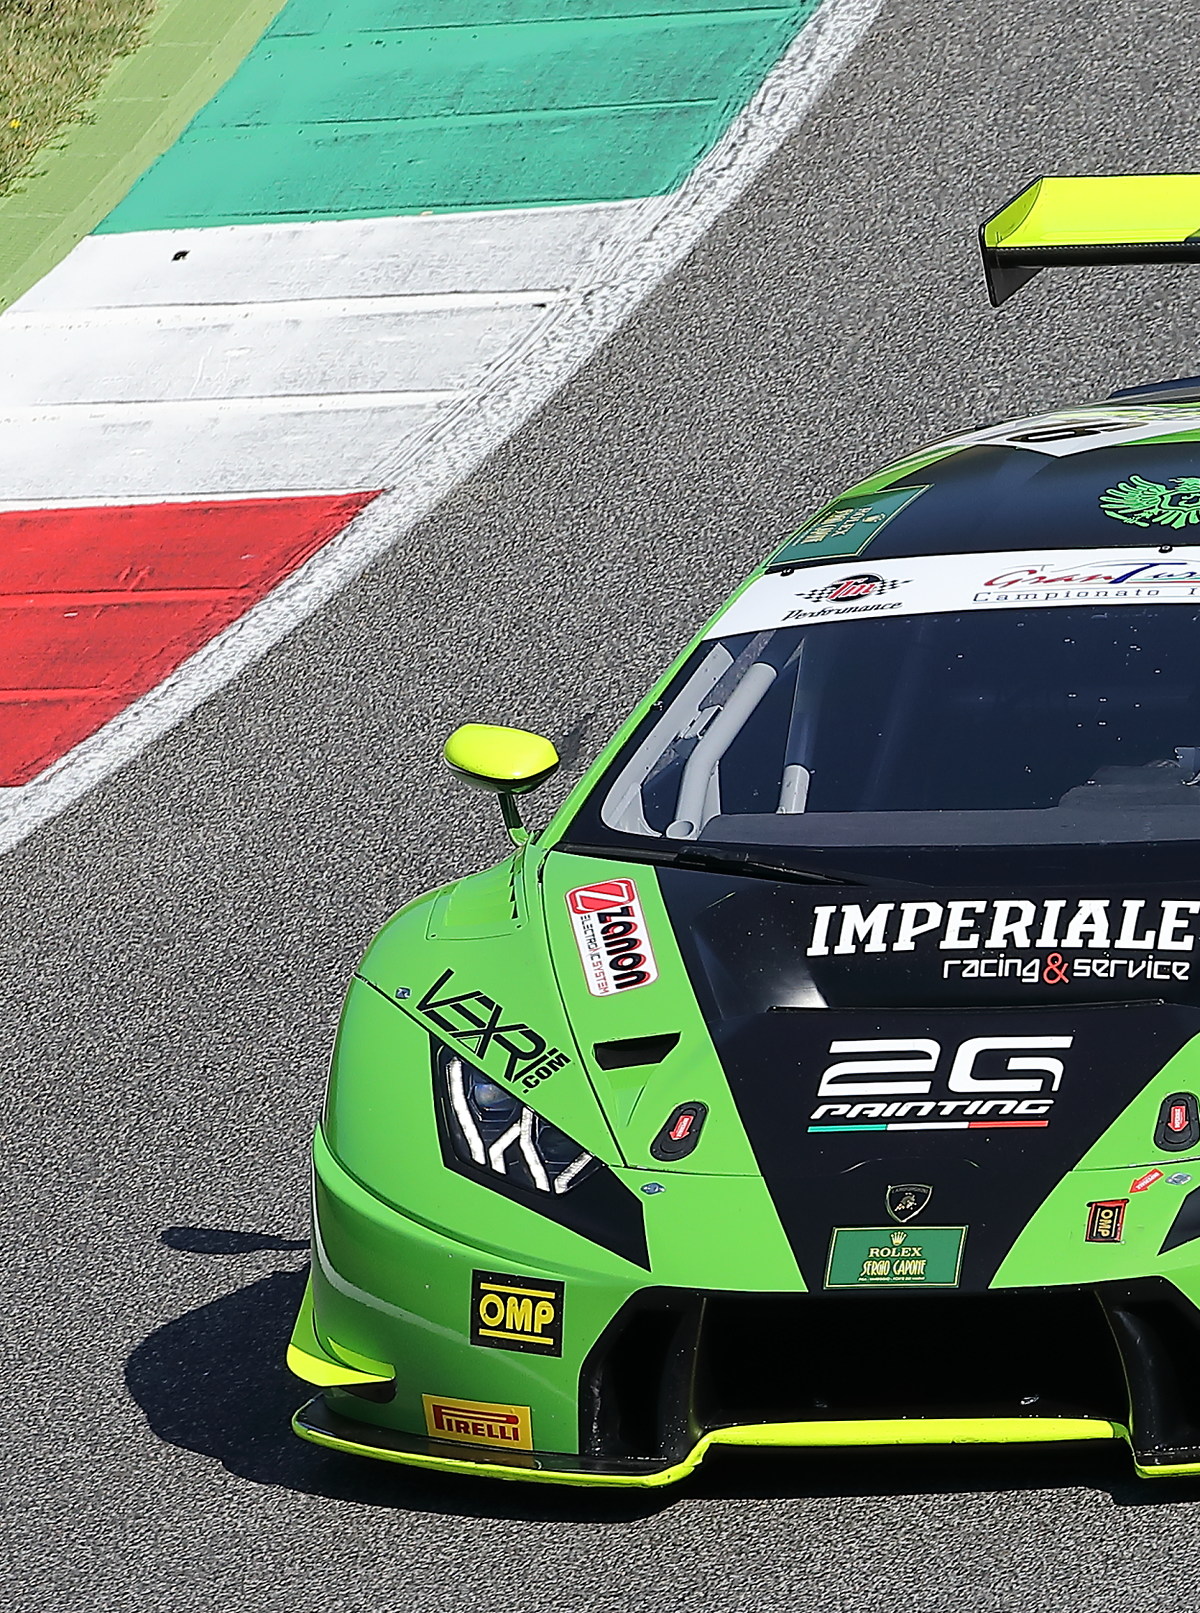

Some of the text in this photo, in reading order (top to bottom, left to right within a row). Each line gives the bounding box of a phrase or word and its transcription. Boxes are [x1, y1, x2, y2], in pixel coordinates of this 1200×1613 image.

[973, 587, 1160, 602] Campionato
[781, 601, 903, 621] Performance
[806, 899, 1200, 957] IMPERIALE
[597, 905, 651, 989] zanon
[592, 961, 609, 994] SYSTEM
[817, 1036, 1074, 1097] 2G
[810, 1099, 1055, 1120] PAINTING
[1098, 1209, 1114, 1237] OMP
[868, 1247, 923, 1257] ROLEX
[860, 1259, 927, 1277] SERGIO CAPONE
[479, 1293, 555, 1334] OMP
[432, 1404, 520, 1441] PIRELLI
